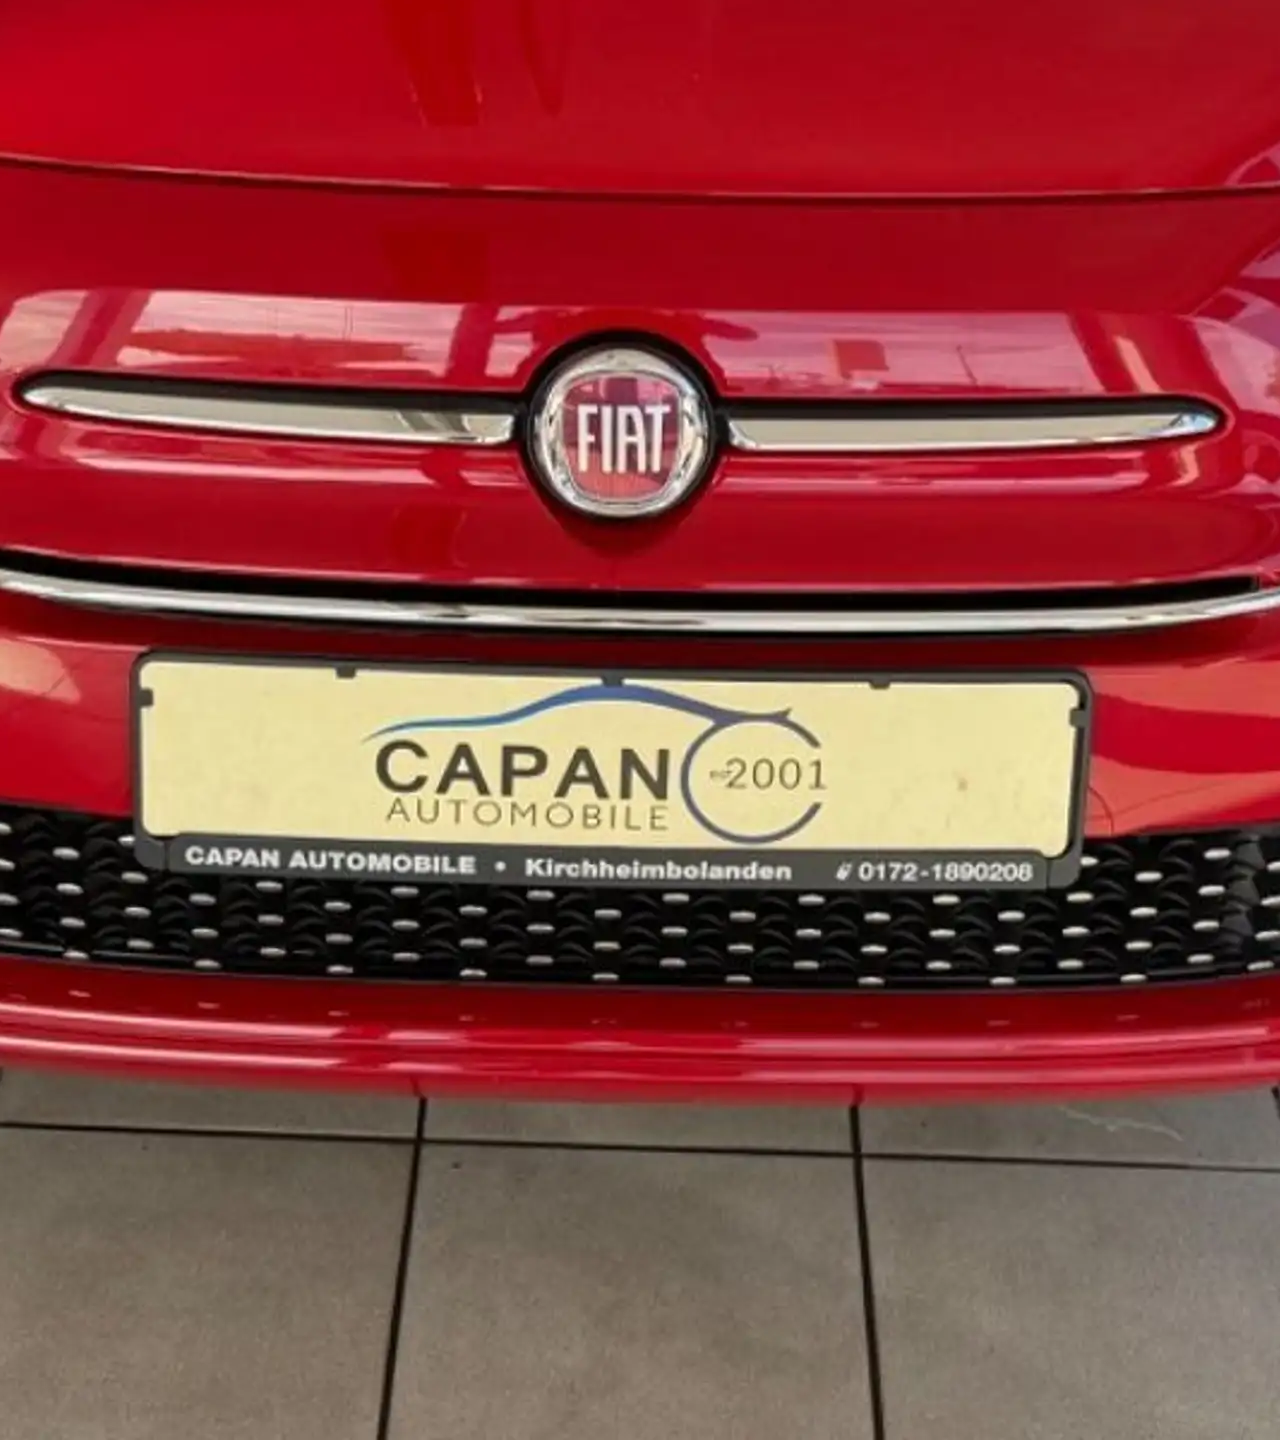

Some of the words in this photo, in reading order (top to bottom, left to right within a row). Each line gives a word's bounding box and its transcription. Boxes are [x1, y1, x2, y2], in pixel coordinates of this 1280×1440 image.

[576, 404, 671, 473] FIAT
[375, 739, 670, 801] CAPAN
[724, 757, 827, 790] 2001
[386, 797, 669, 831] AUTOMOBILE
[185, 846, 280, 869] CAPAN
[289, 850, 477, 875] AUTOMOBILE
[525, 858, 793, 881] Kirchheimbolanden
[857, 862, 1034, 883] 0172-1890208
